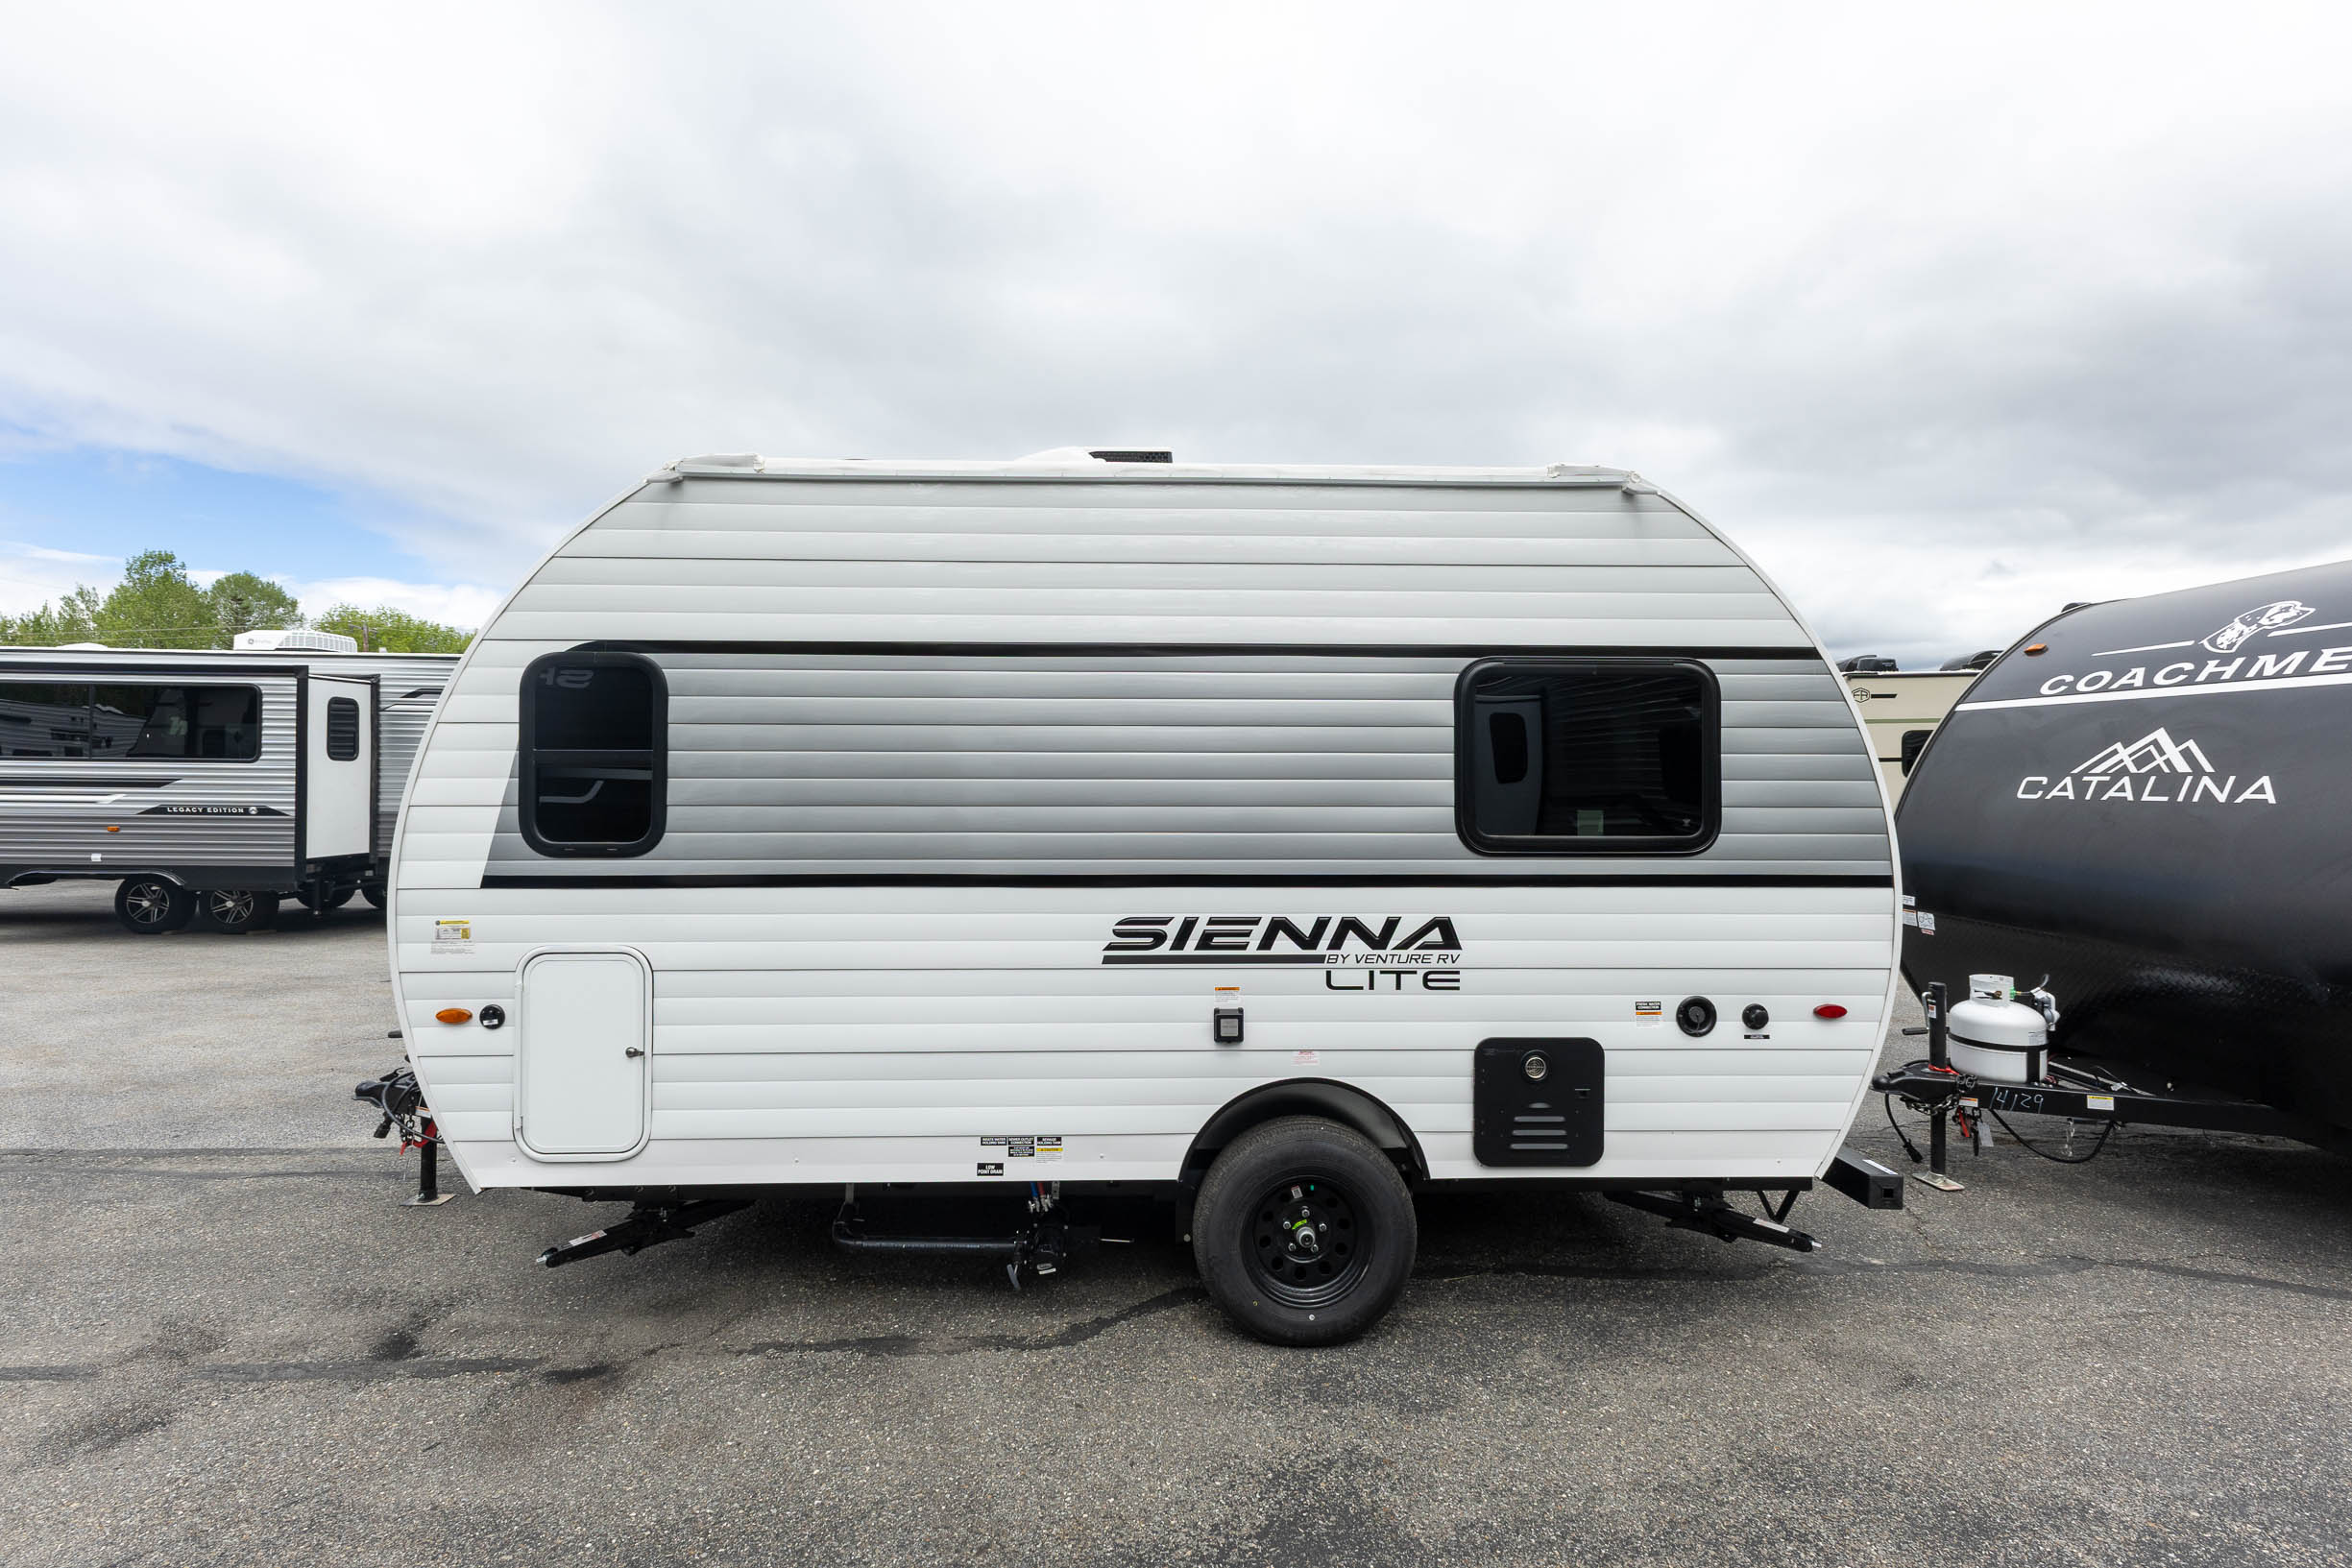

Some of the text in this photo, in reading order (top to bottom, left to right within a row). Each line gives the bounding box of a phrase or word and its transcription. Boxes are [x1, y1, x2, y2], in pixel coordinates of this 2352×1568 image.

[2040, 646, 2352, 695] COACHME
[2017, 775, 2276, 805] CATALINA
[1102, 916, 1463, 951] SIENNA
[1326, 953, 1461, 964] BY VENTURE RV
[1325, 970, 1461, 991] LITE
